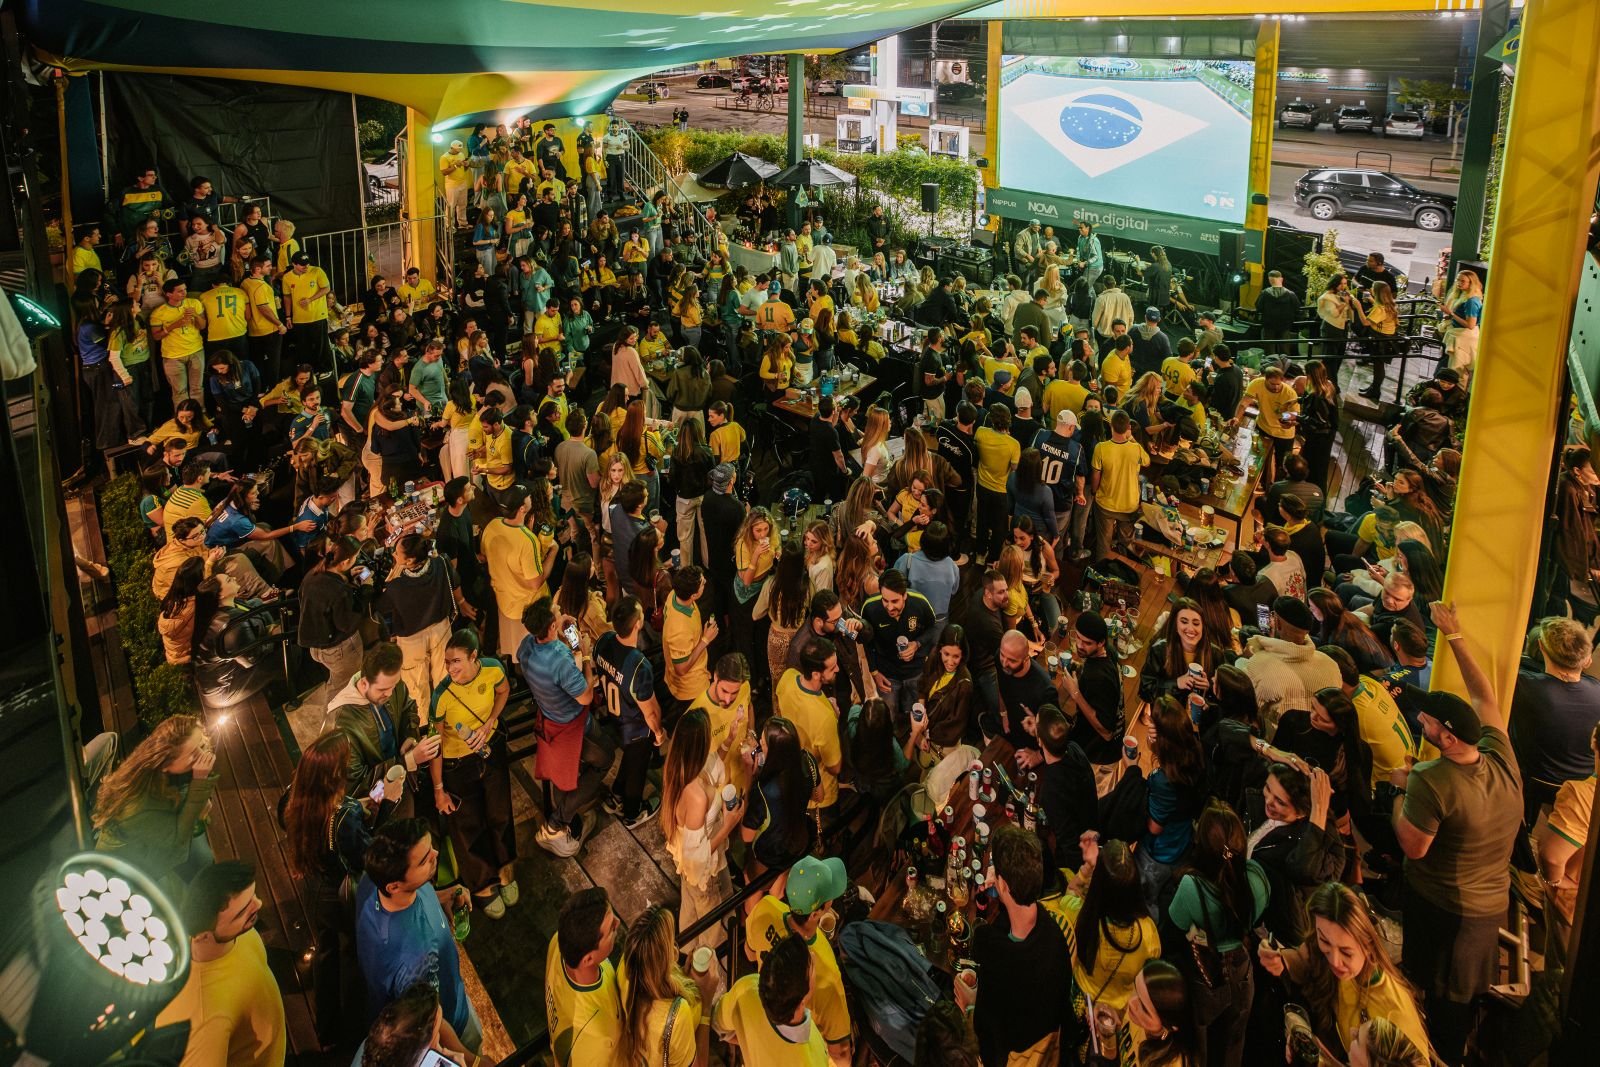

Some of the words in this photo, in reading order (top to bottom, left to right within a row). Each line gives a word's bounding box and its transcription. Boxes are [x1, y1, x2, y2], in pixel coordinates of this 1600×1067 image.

[1028, 201, 1059, 216] NOVA
[1073, 207, 1149, 231] sim.digital
[216, 294, 237, 318] 19
[765, 306, 775, 323] 11
[1041, 442, 1062, 457] NEYMAR
[1061, 451, 1070, 460] JR
[1041, 456, 1064, 485] 10
[600, 674, 621, 717] 10
